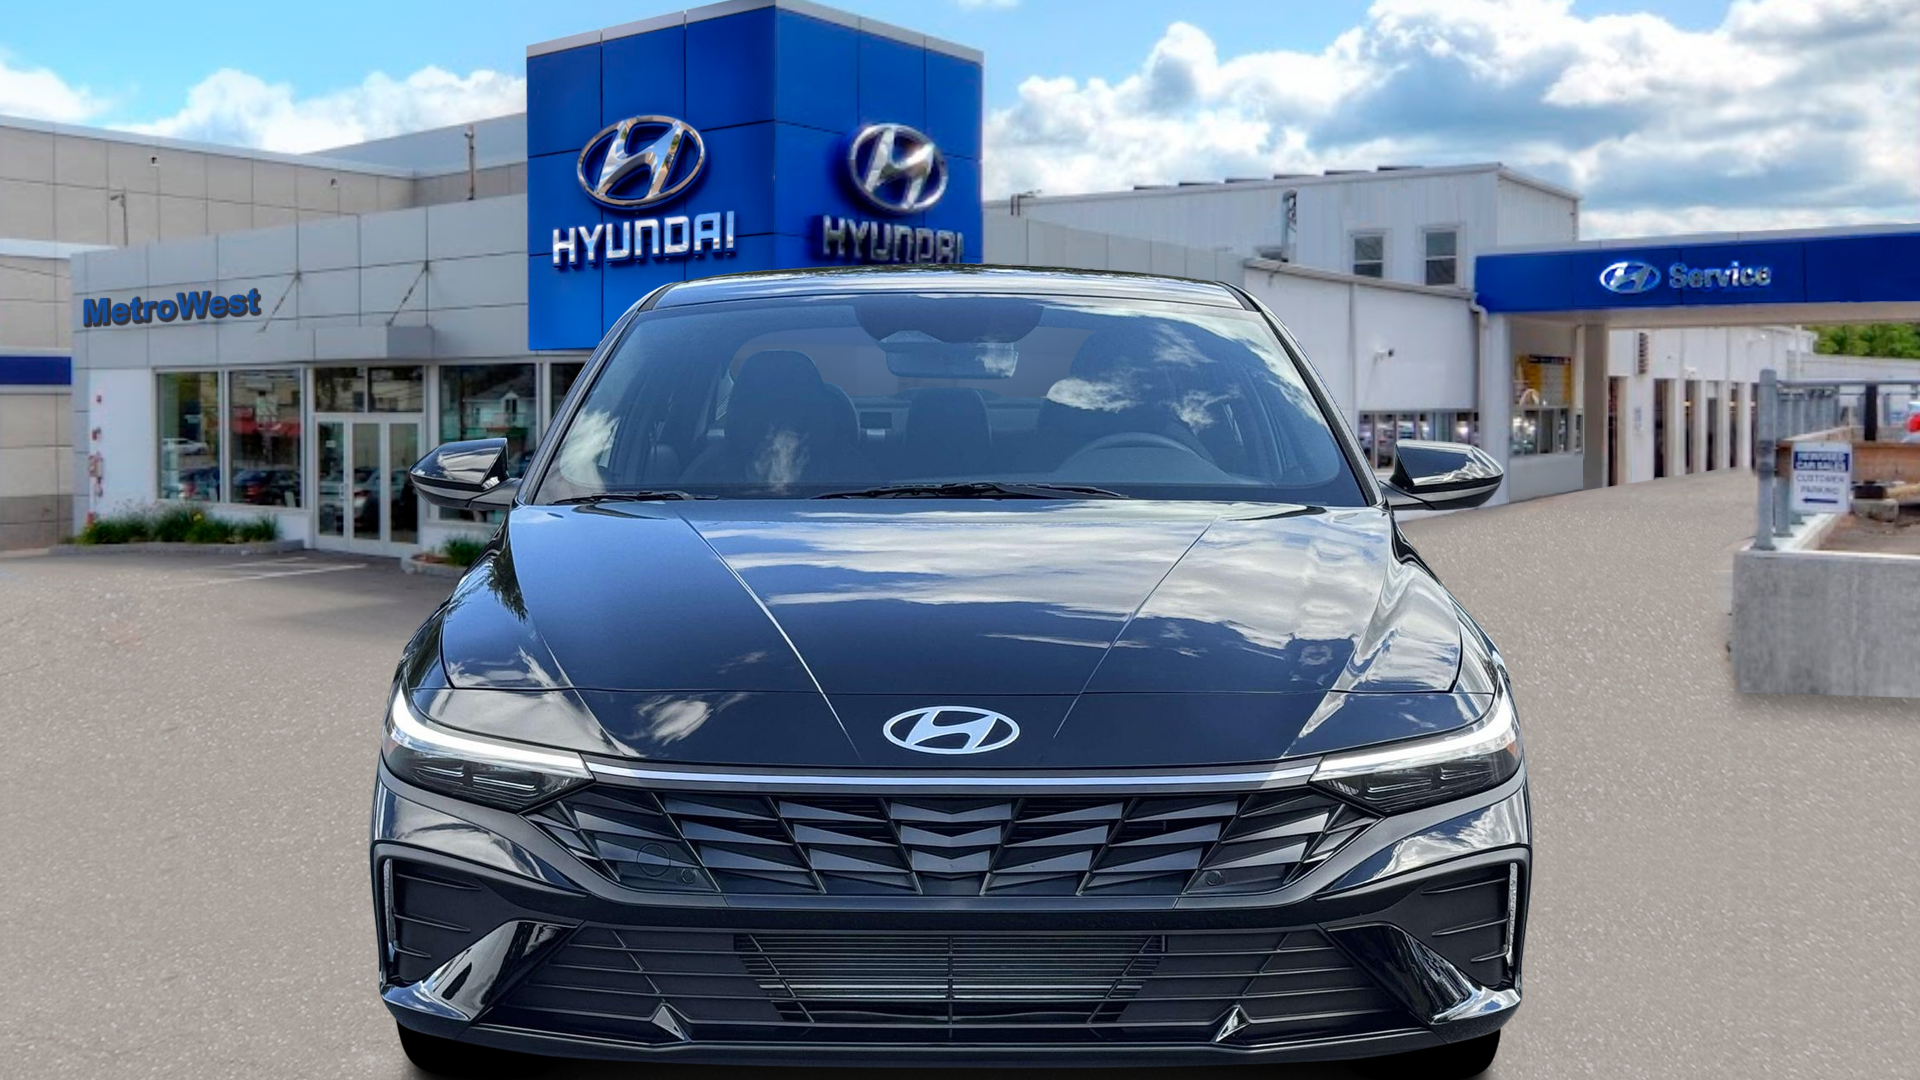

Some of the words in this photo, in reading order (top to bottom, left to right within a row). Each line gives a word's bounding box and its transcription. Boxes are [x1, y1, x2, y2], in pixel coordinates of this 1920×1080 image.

[553, 211, 735, 268] HYUNDAI
[823, 215, 965, 264] HYUNDAI
[1669, 261, 1772, 289] Service
[83, 288, 262, 328] MetroWest
[1796, 474, 1845, 483] CUSTOMER
[1800, 485, 1840, 494] PARKING
